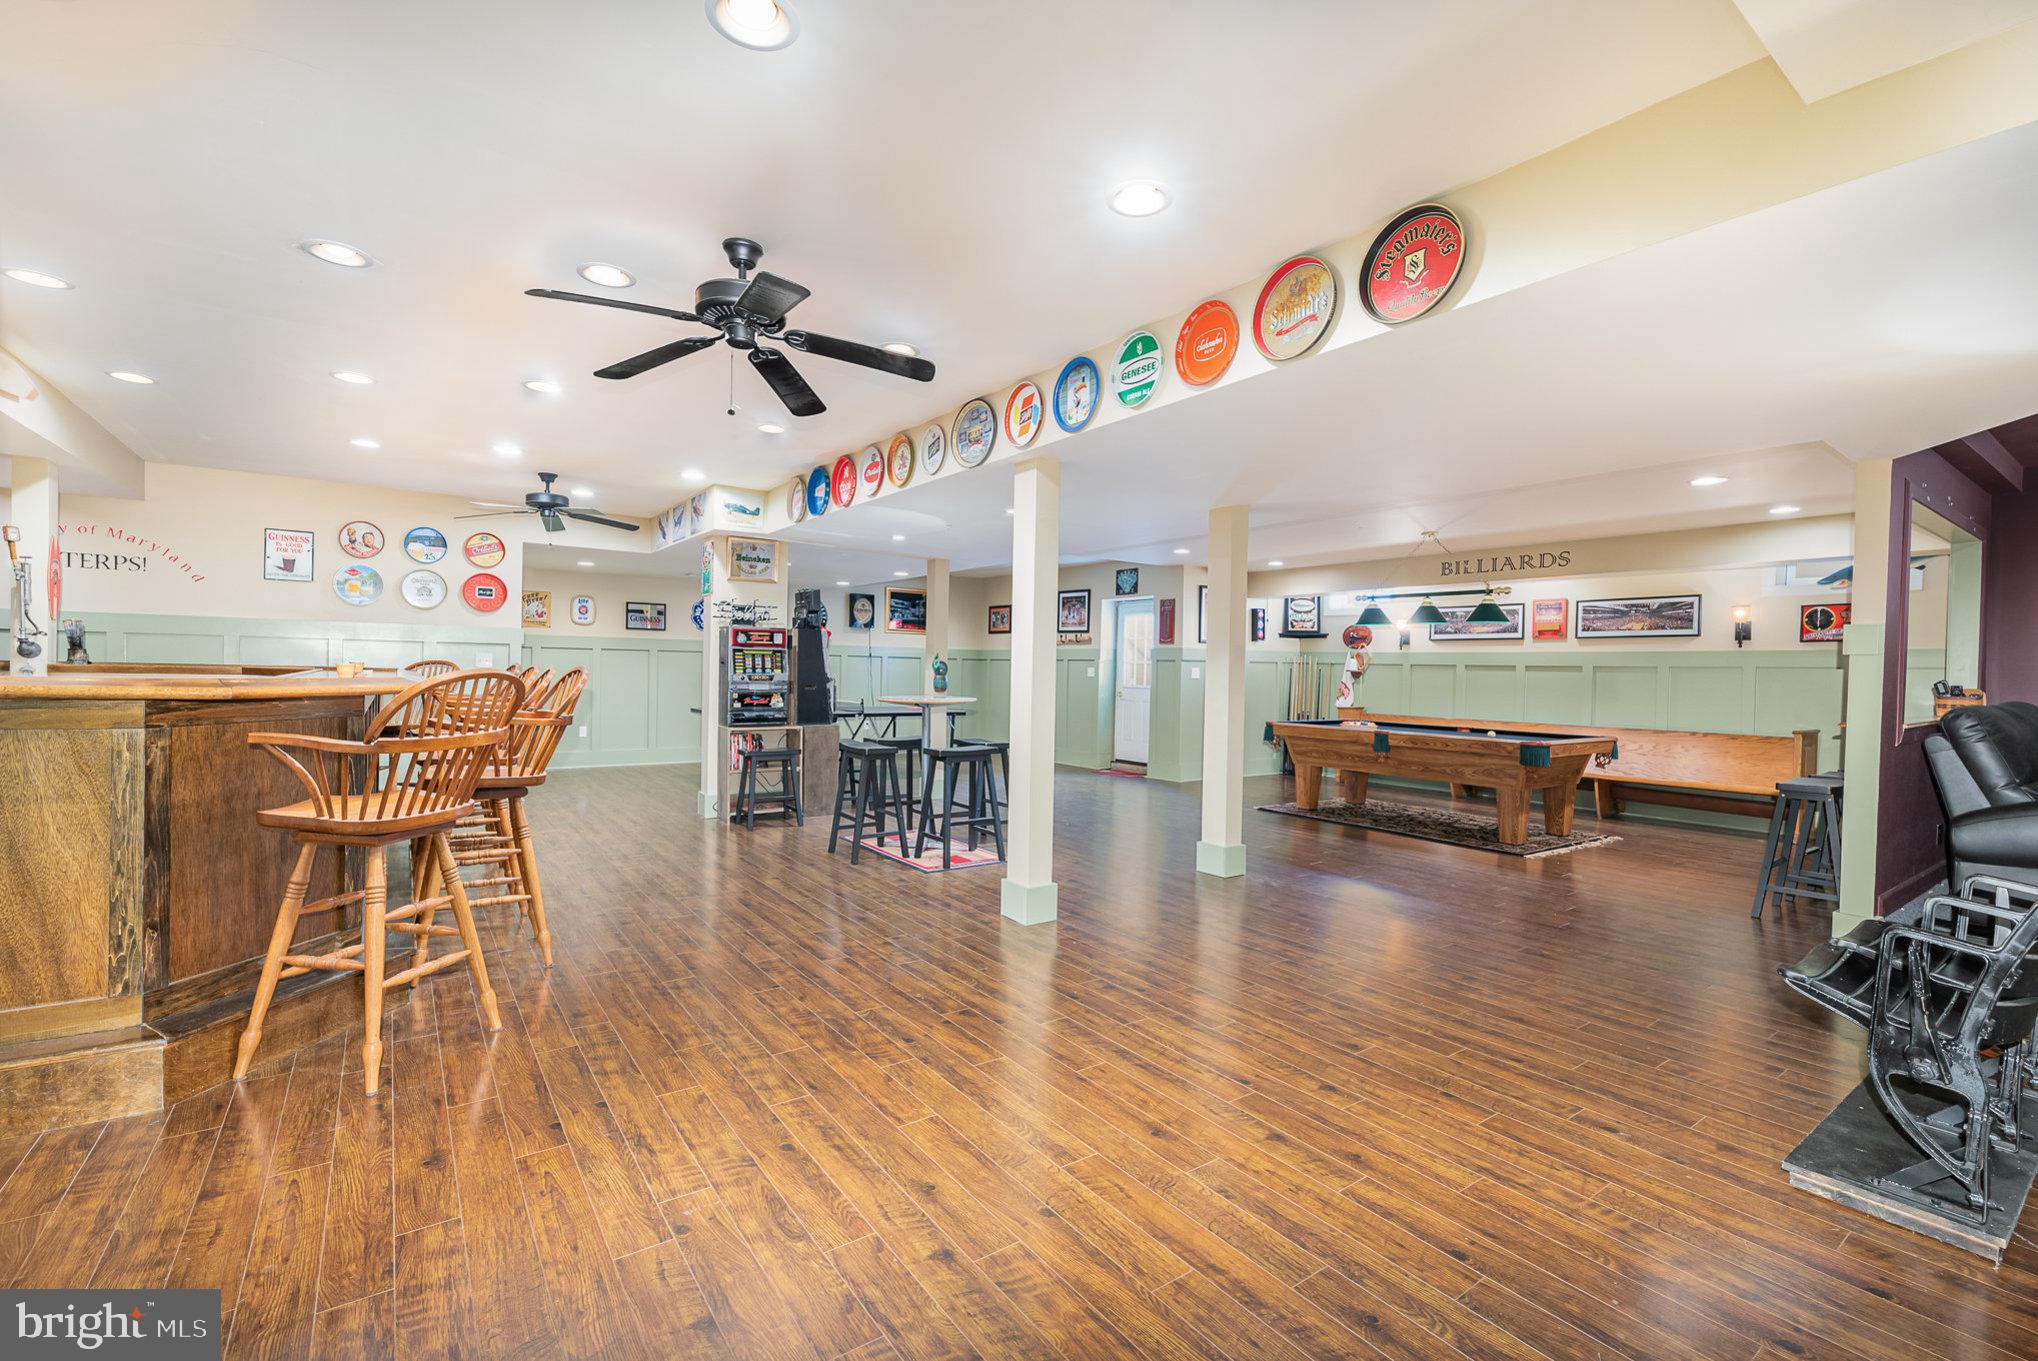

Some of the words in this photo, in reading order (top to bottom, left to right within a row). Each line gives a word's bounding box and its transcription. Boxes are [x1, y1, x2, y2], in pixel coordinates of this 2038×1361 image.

[1121, 361, 1157, 381] GENESEE
[268, 532, 310, 543] GUINNESS
[60, 551, 147, 572] TERPS!
[77, 524, 97, 535] of
[107, 526, 205, 583] Maryland
[735, 553, 771, 564] Heineken
[1441, 551, 1571, 577] BILLIARDS
